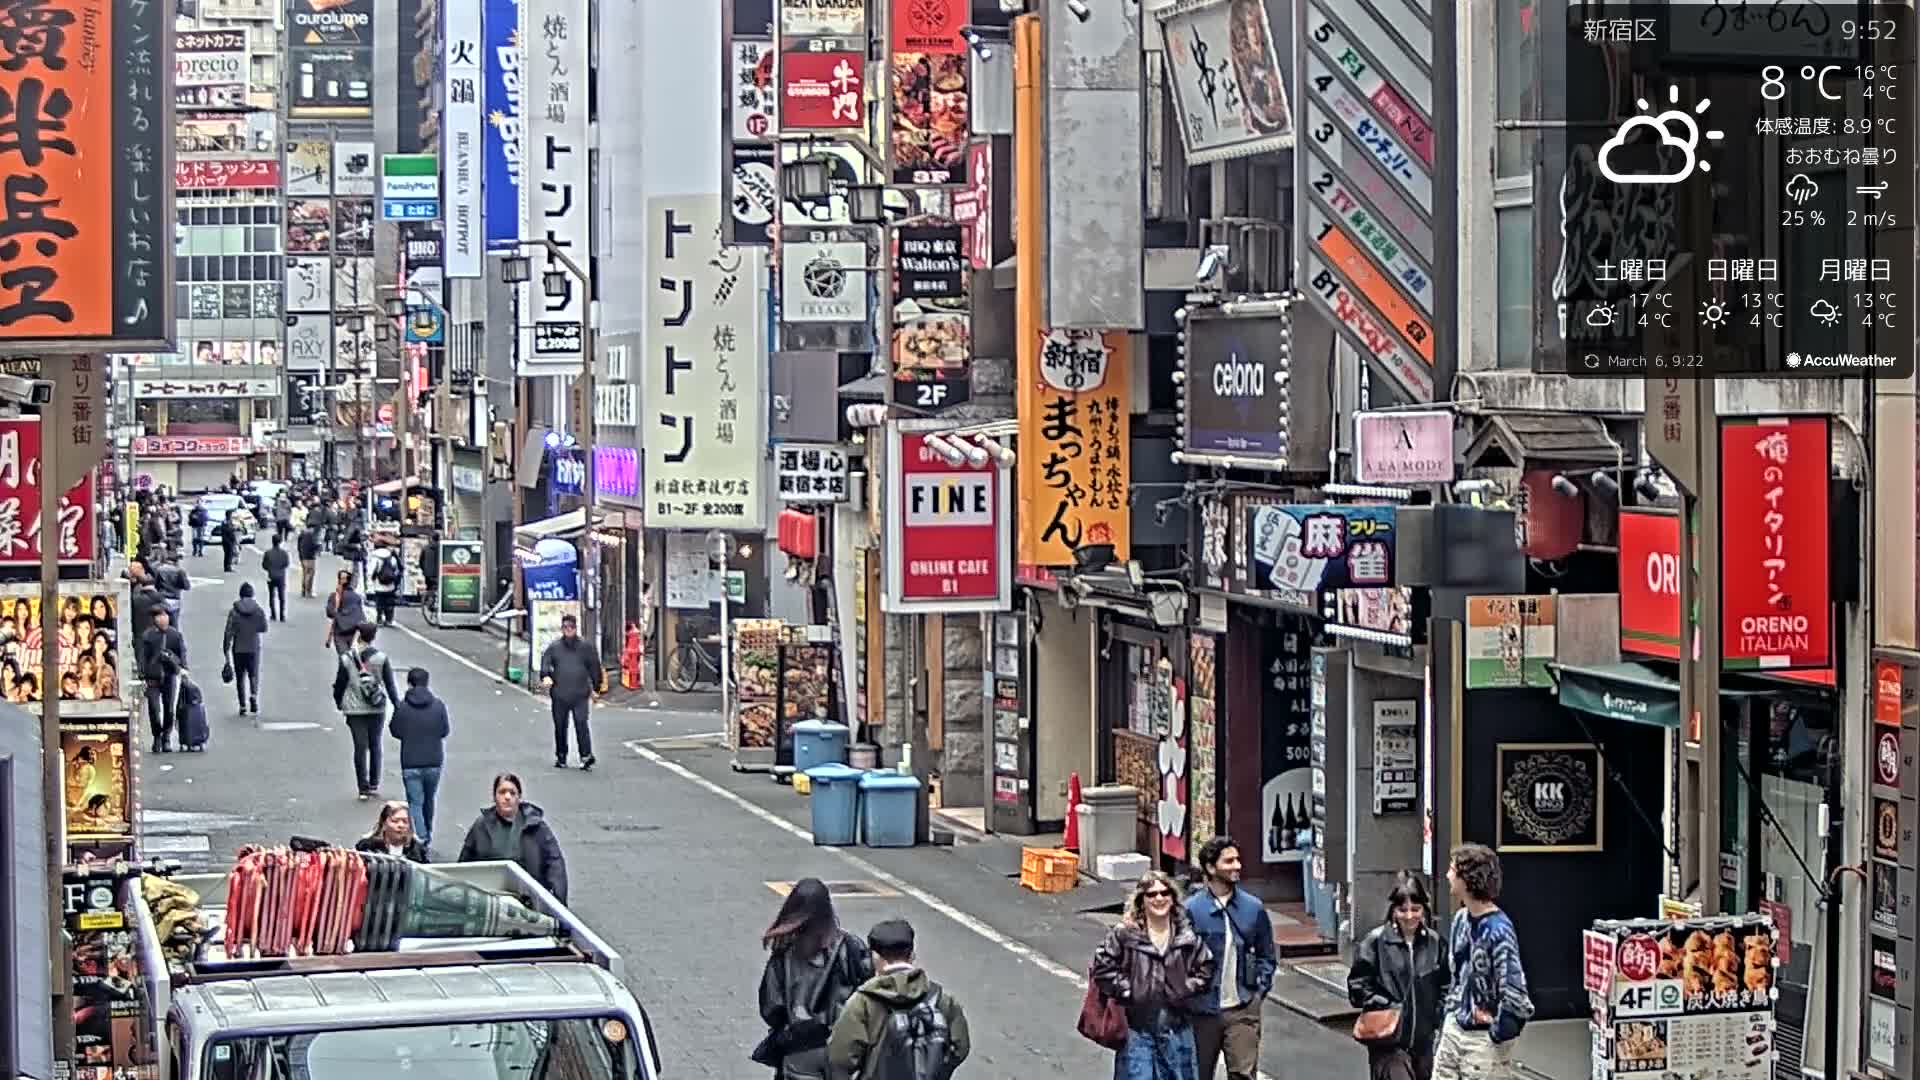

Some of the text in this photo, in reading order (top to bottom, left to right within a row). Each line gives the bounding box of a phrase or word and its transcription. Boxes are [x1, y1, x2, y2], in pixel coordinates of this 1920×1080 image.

[1314, 22, 1336, 43] 5
[450, 39, 475, 104] 火鍋
[1314, 73, 1335, 92] 4
[1314, 123, 1335, 144] 3
[386, 181, 437, 192] FamilyMart
[1312, 172, 1334, 194] 2
[456, 203, 470, 256] HOTPOT
[541, 135, 572, 312] トントン
[1316, 222, 1333, 241] 1
[900, 256, 961, 272] Walton's
[1311, 269, 1339, 299] B1
[659, 209, 693, 464] トントン
[1044, 340, 1104, 375] 新宿
[1212, 352, 1265, 396] celona
[71, 354, 93, 446] 通り一番街
[916, 385, 948, 406] 2F
[779, 450, 844, 472] 酒場心
[1040, 395, 1087, 550] まっちゃん
[911, 484, 987, 514] FINE
[1349, 520, 1392, 536] フリー
[1754, 431, 1789, 606] 俺のイタリアン
[910, 559, 990, 575] ONLINE CAFE
[1741, 614, 1809, 633] ORENO
[1740, 634, 1809, 653] ITALIAN
[1534, 782, 1565, 801] KK
[1619, 987, 1653, 1009] 4F
[1686, 988, 1769, 1011] 炭火焼き鳥
